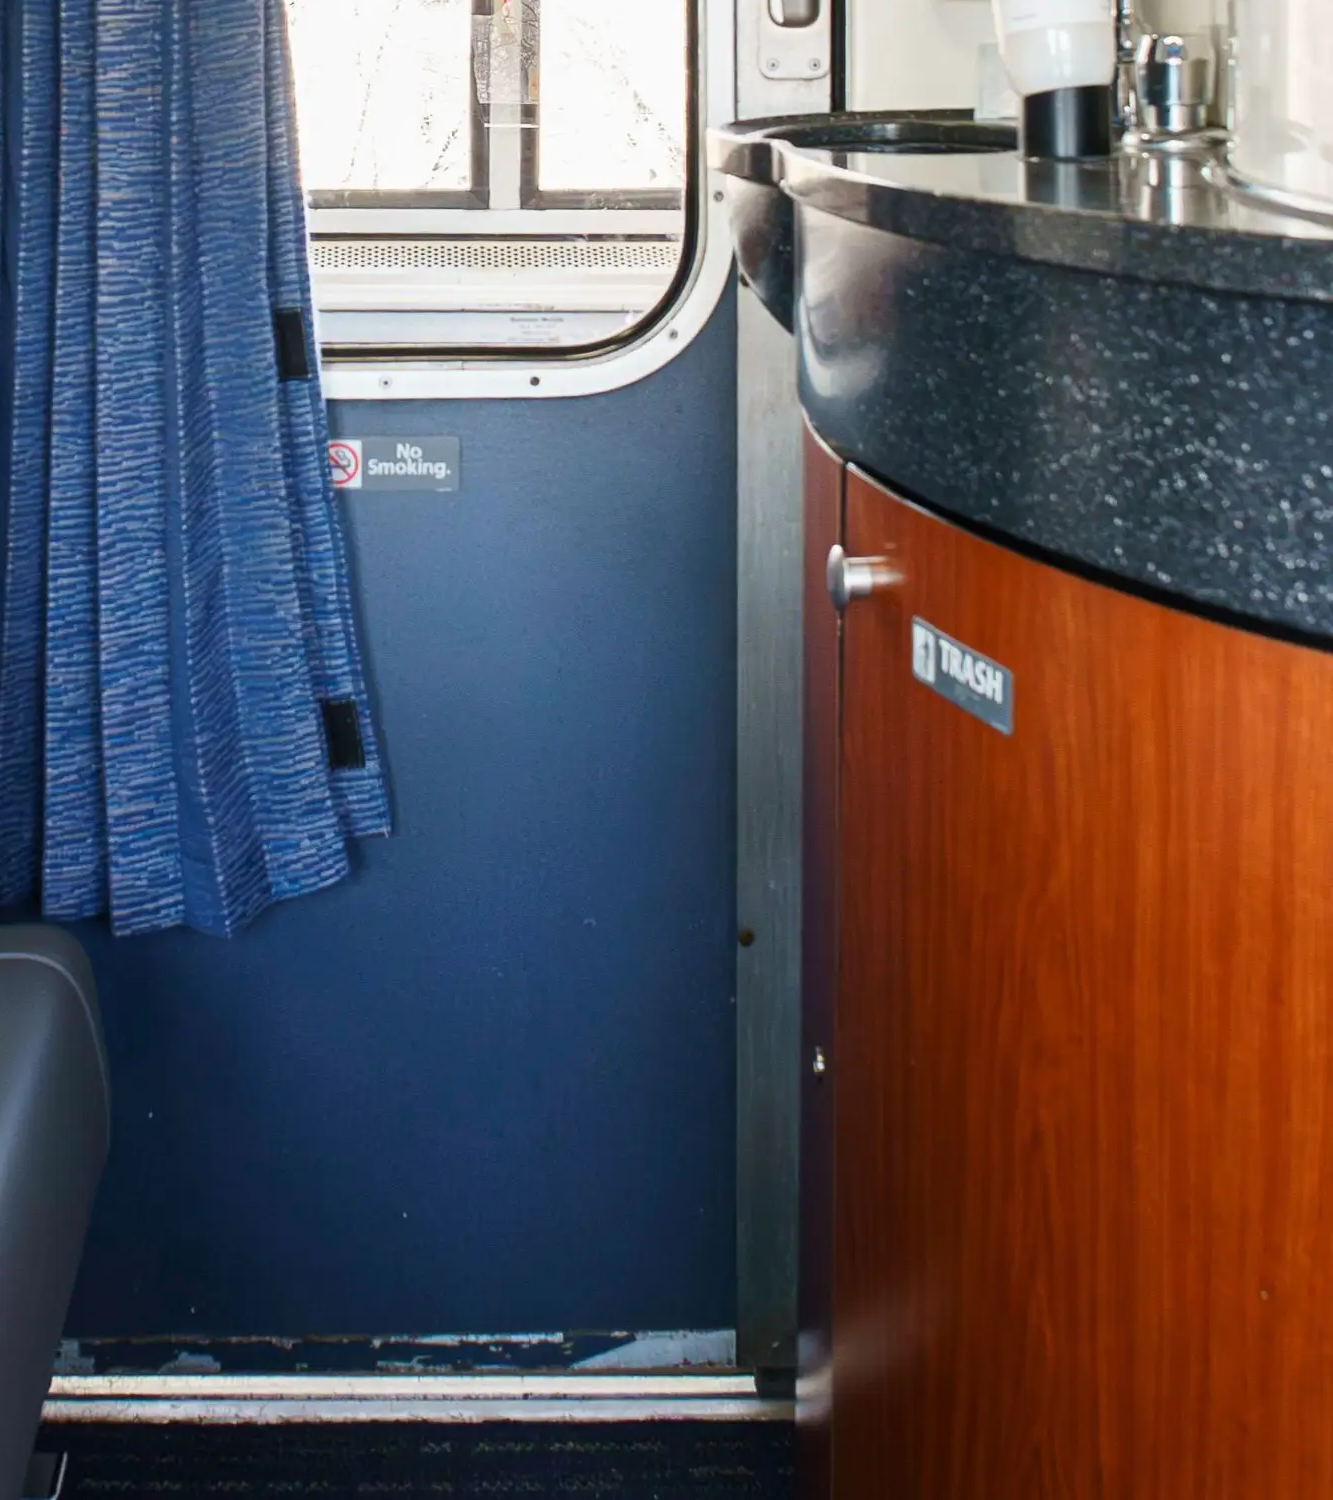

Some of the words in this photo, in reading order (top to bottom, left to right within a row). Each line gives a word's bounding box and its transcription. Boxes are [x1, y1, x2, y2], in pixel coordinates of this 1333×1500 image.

[396, 443, 423, 459] No
[367, 458, 452, 479] Smoking.
[938, 638, 1004, 705] TRASH
